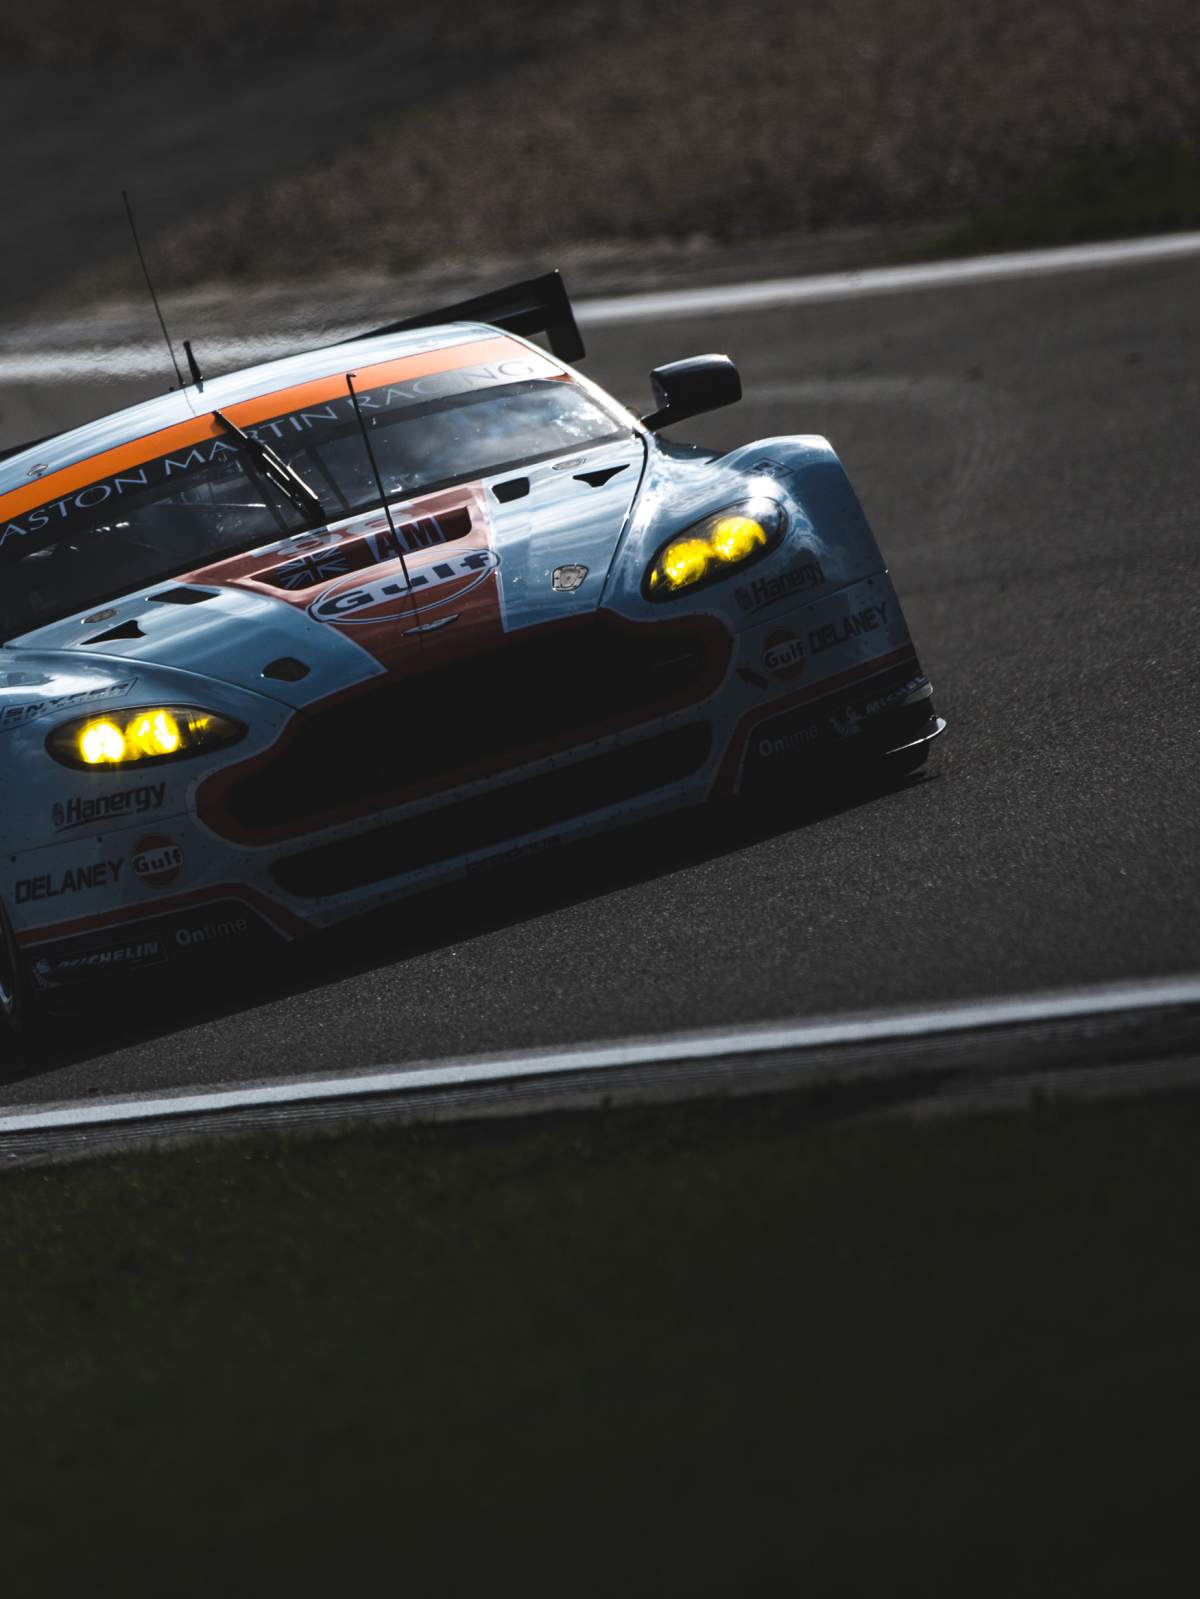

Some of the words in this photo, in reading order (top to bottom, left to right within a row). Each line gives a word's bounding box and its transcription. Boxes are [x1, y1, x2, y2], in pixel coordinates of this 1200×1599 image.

[0, 468, 148, 547] ASTON
[318, 552, 490, 614] Gulf
[751, 561, 824, 605] Hanergy
[808, 602, 889, 655] DELANEY
[764, 644, 807, 669] Gulf
[66, 782, 166, 824] Hanergy
[15, 858, 126, 904] DELANEY
[132, 847, 183, 874] Gulf
[175, 917, 248, 946] Ontime
[57, 941, 160, 970] MICHELIN
